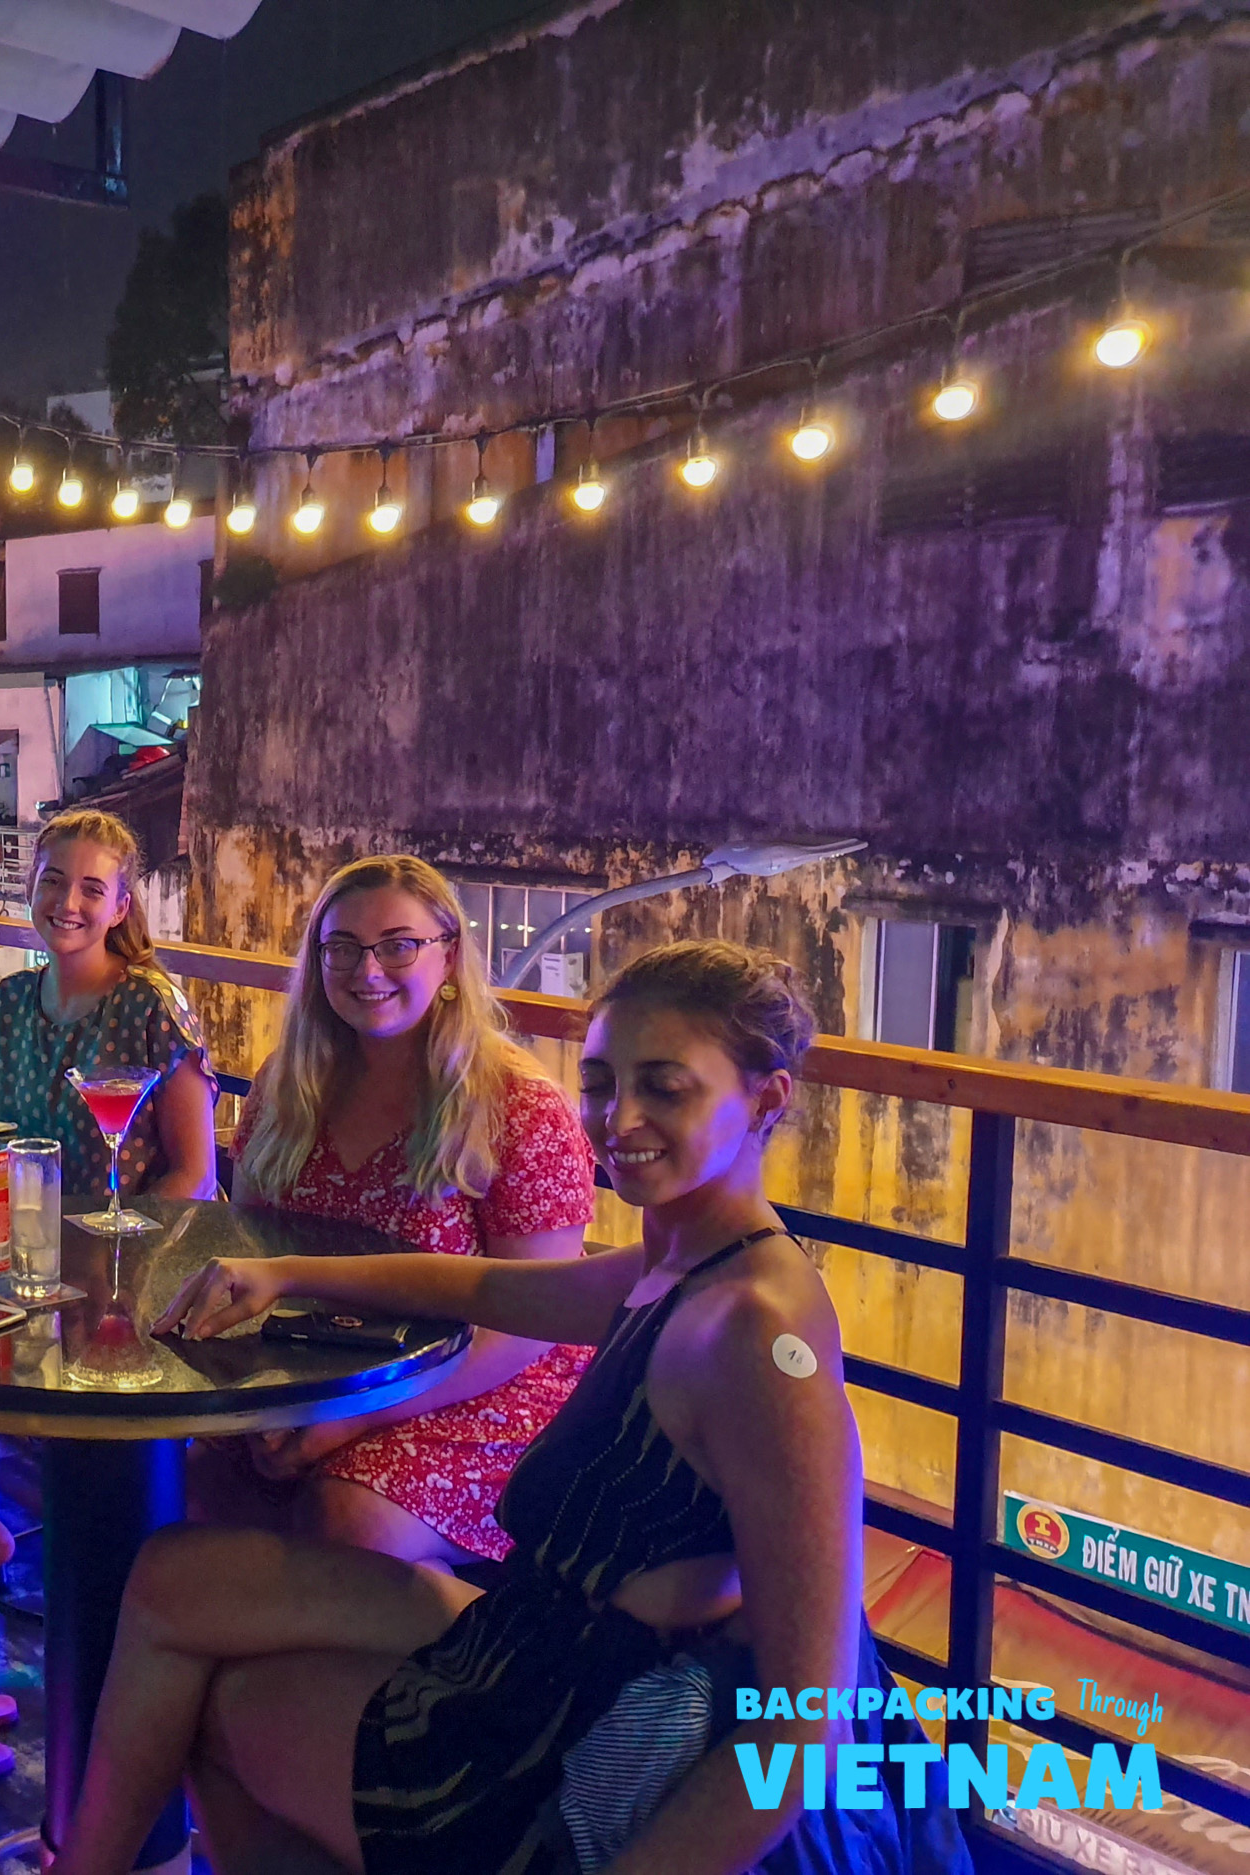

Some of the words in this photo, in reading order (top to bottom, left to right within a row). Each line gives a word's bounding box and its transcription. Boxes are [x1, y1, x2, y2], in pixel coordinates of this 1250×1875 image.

[1082, 1527, 1138, 1585] ĐIỂM
[1144, 1554, 1184, 1599] GIỮ
[1187, 1569, 1217, 1612] XE
